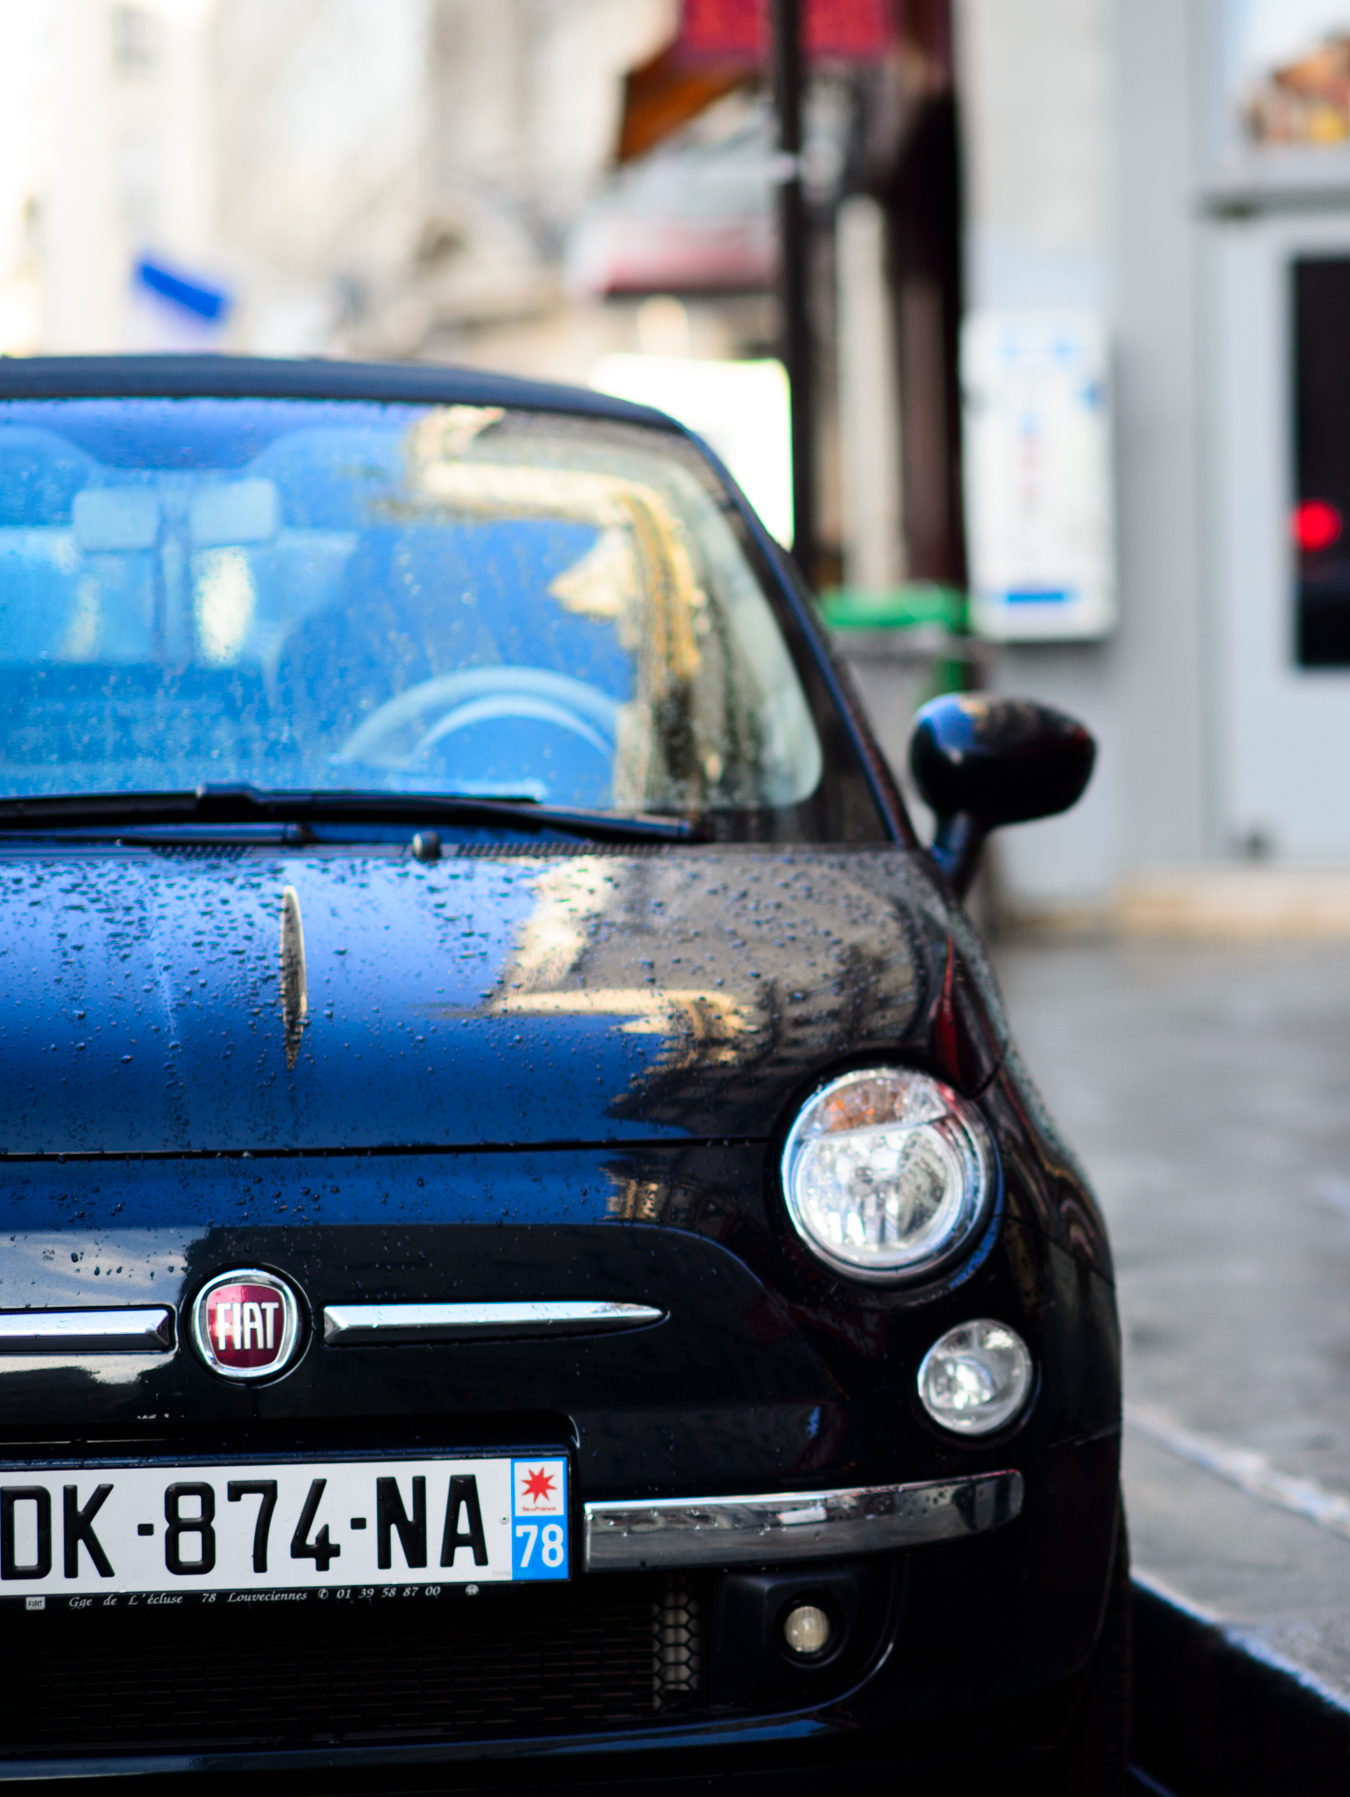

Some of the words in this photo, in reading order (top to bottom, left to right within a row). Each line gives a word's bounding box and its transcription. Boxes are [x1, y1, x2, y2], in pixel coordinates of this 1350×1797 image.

[216, 1302, 279, 1350] FIAT
[1, 1474, 489, 1580] DK-874-NA
[516, 1524, 564, 1568] 78
[69, 1597, 92, 1609] Gge
[103, 1594, 117, 1606] de
[202, 1592, 217, 1603] 78
[226, 1590, 308, 1603] Louveciennes
[336, 1589, 351, 1599] 01
[358, 1588, 375, 1598] 39
[381, 1587, 397, 1598] 58
[403, 1586, 418, 1597] 87
[425, 1586, 441, 1596] 00
